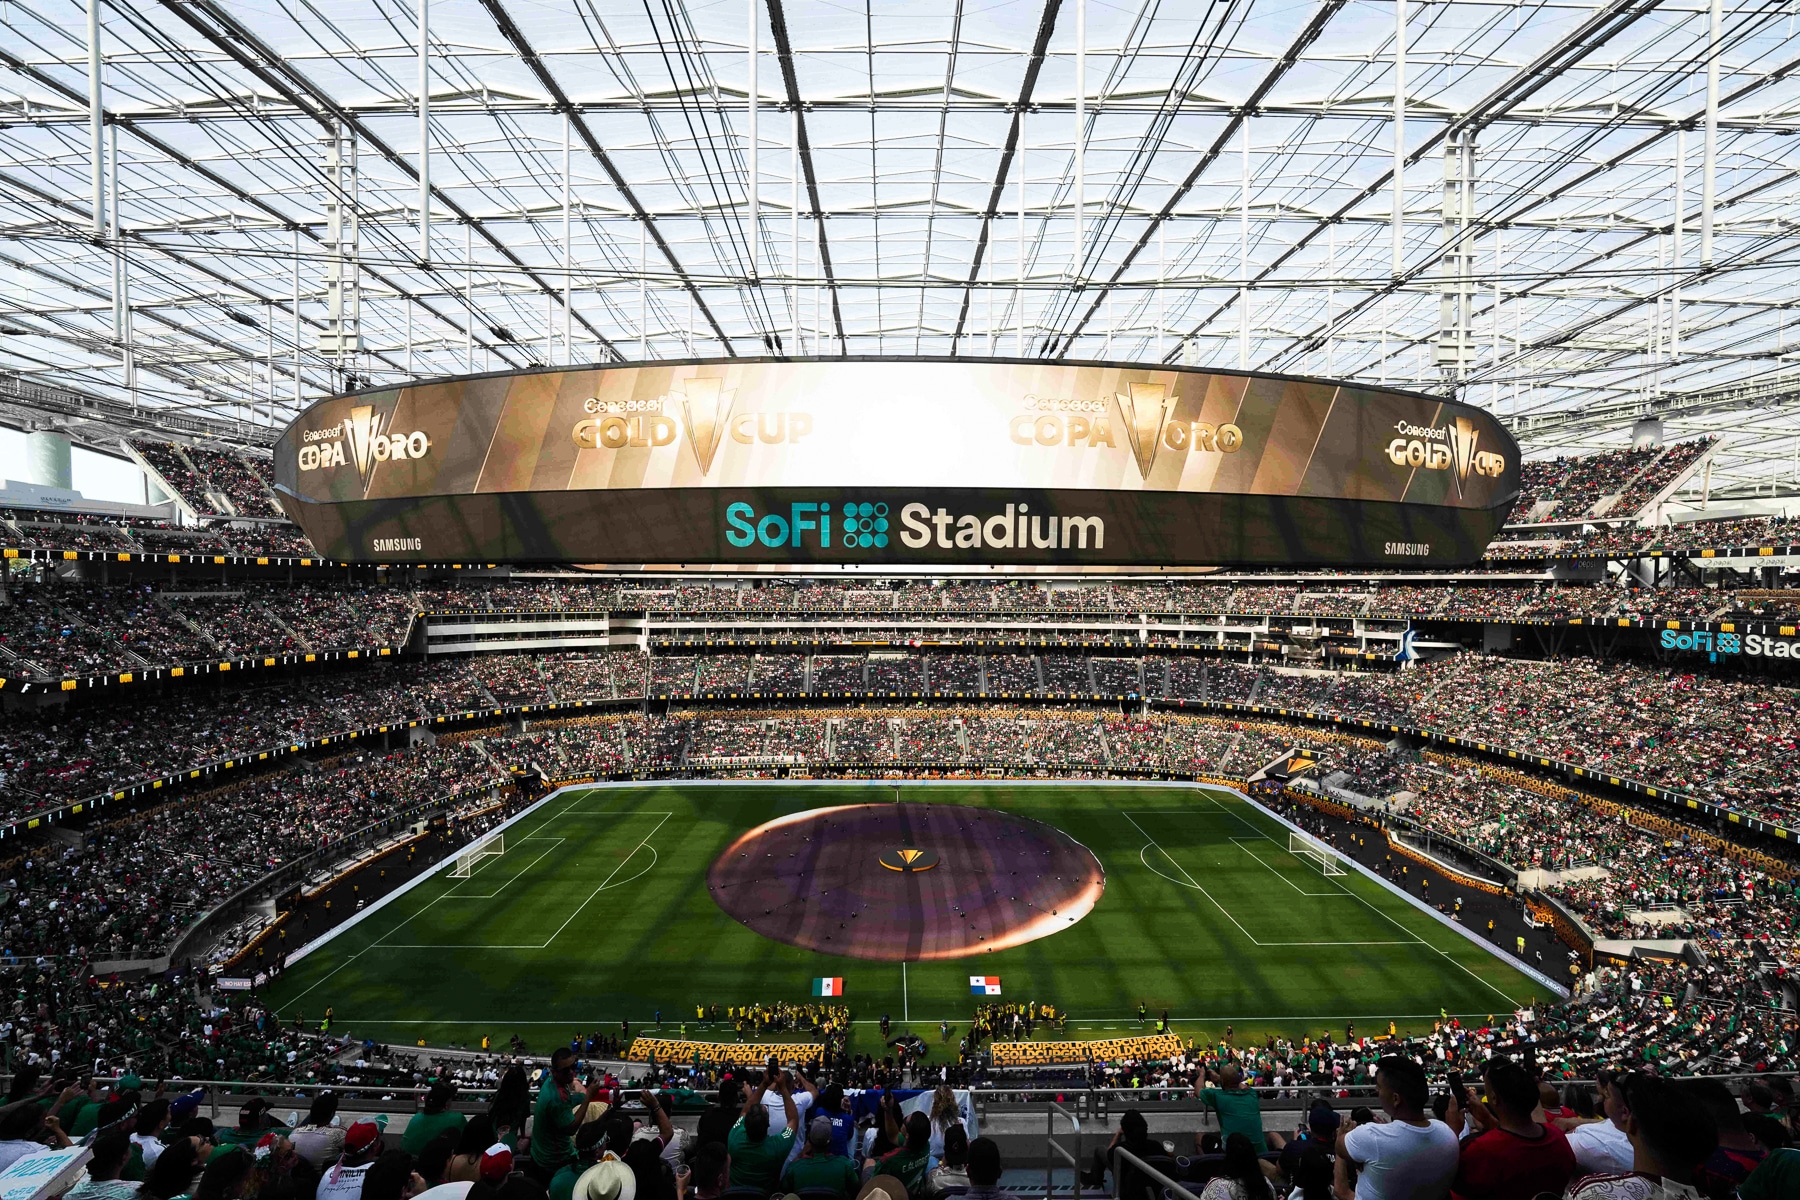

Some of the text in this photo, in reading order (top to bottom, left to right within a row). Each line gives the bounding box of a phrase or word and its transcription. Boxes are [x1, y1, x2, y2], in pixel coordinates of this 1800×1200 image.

[584, 395, 667, 414] Concacaf
[1023, 394, 1110, 413] Concacaf
[303, 423, 344, 443] Concacaf
[571, 412, 814, 449] GOLD CUP
[1008, 415, 1243, 453] COPA ORO
[1397, 420, 1446, 440] Concacaf
[298, 430, 430, 471] COPA ORO
[1388, 438, 1505, 478] GOLD CUP
[725, 502, 1105, 549] SoFi Stadium
[373, 538, 422, 551] SAMSUNG
[1384, 542, 1430, 556] SAMSUNG
[1578, 559, 1596, 569] pepsi
[1660, 629, 1713, 652] SoFi
